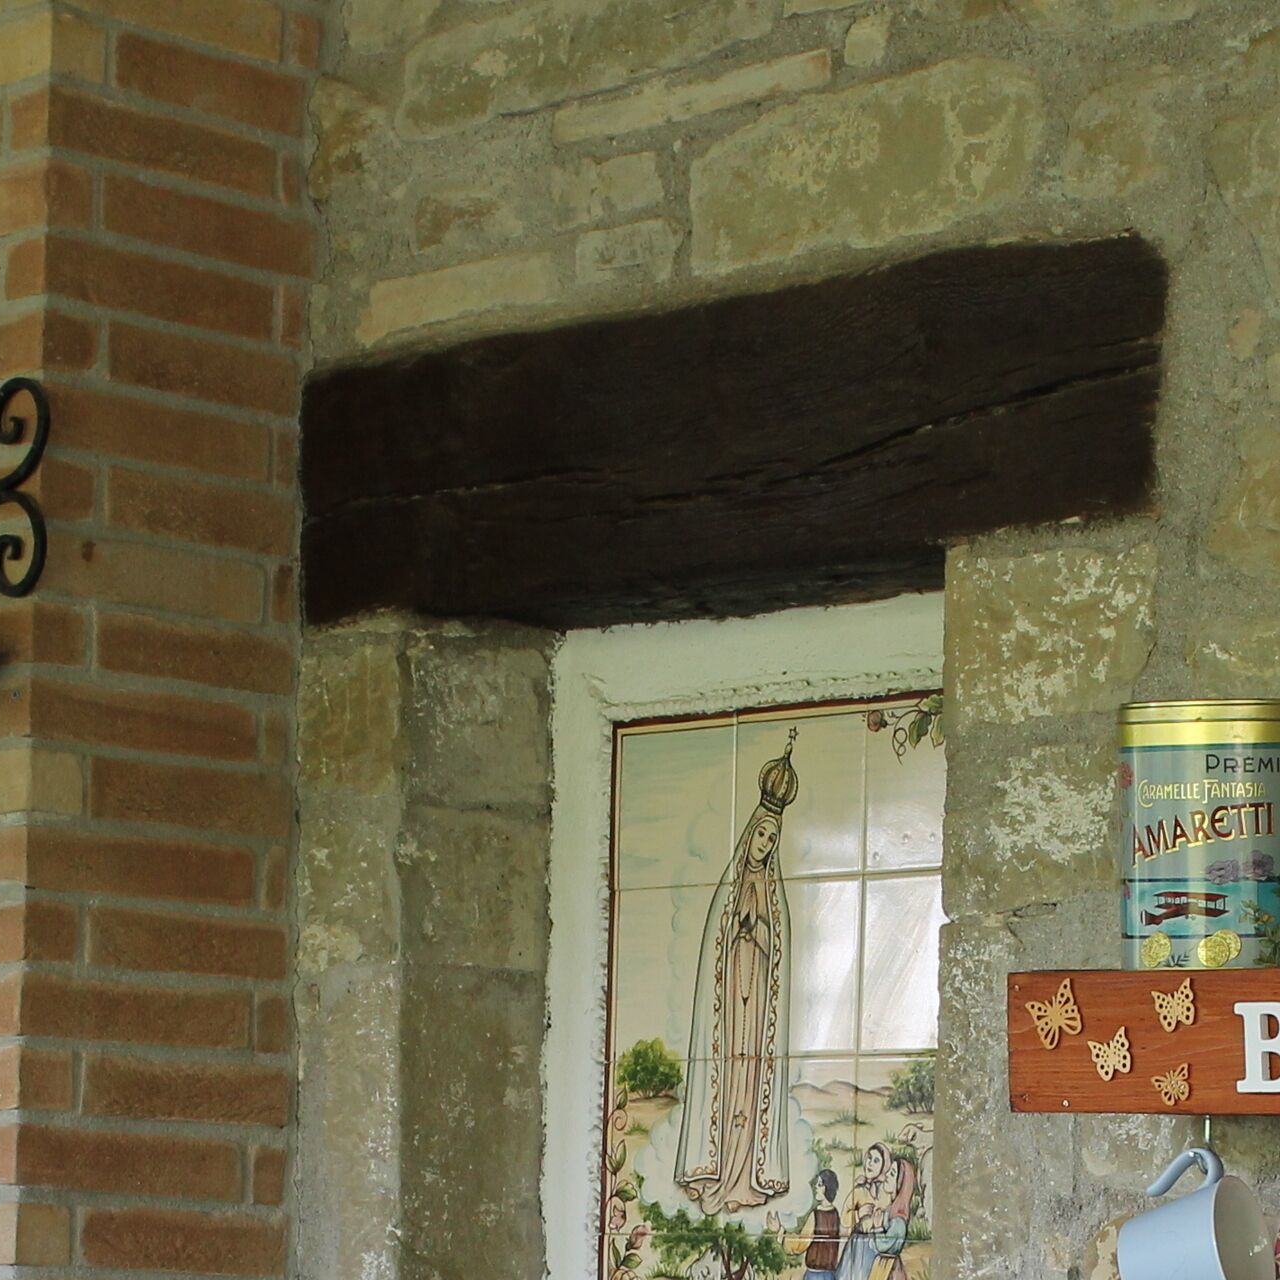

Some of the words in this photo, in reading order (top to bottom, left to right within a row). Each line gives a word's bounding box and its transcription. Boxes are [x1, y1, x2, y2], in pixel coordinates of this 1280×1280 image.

[1138, 779, 1200, 807] CARAMELLE
[1202, 779, 1266, 804] FANTASIA
[1131, 802, 1275, 868] AMARETTI
